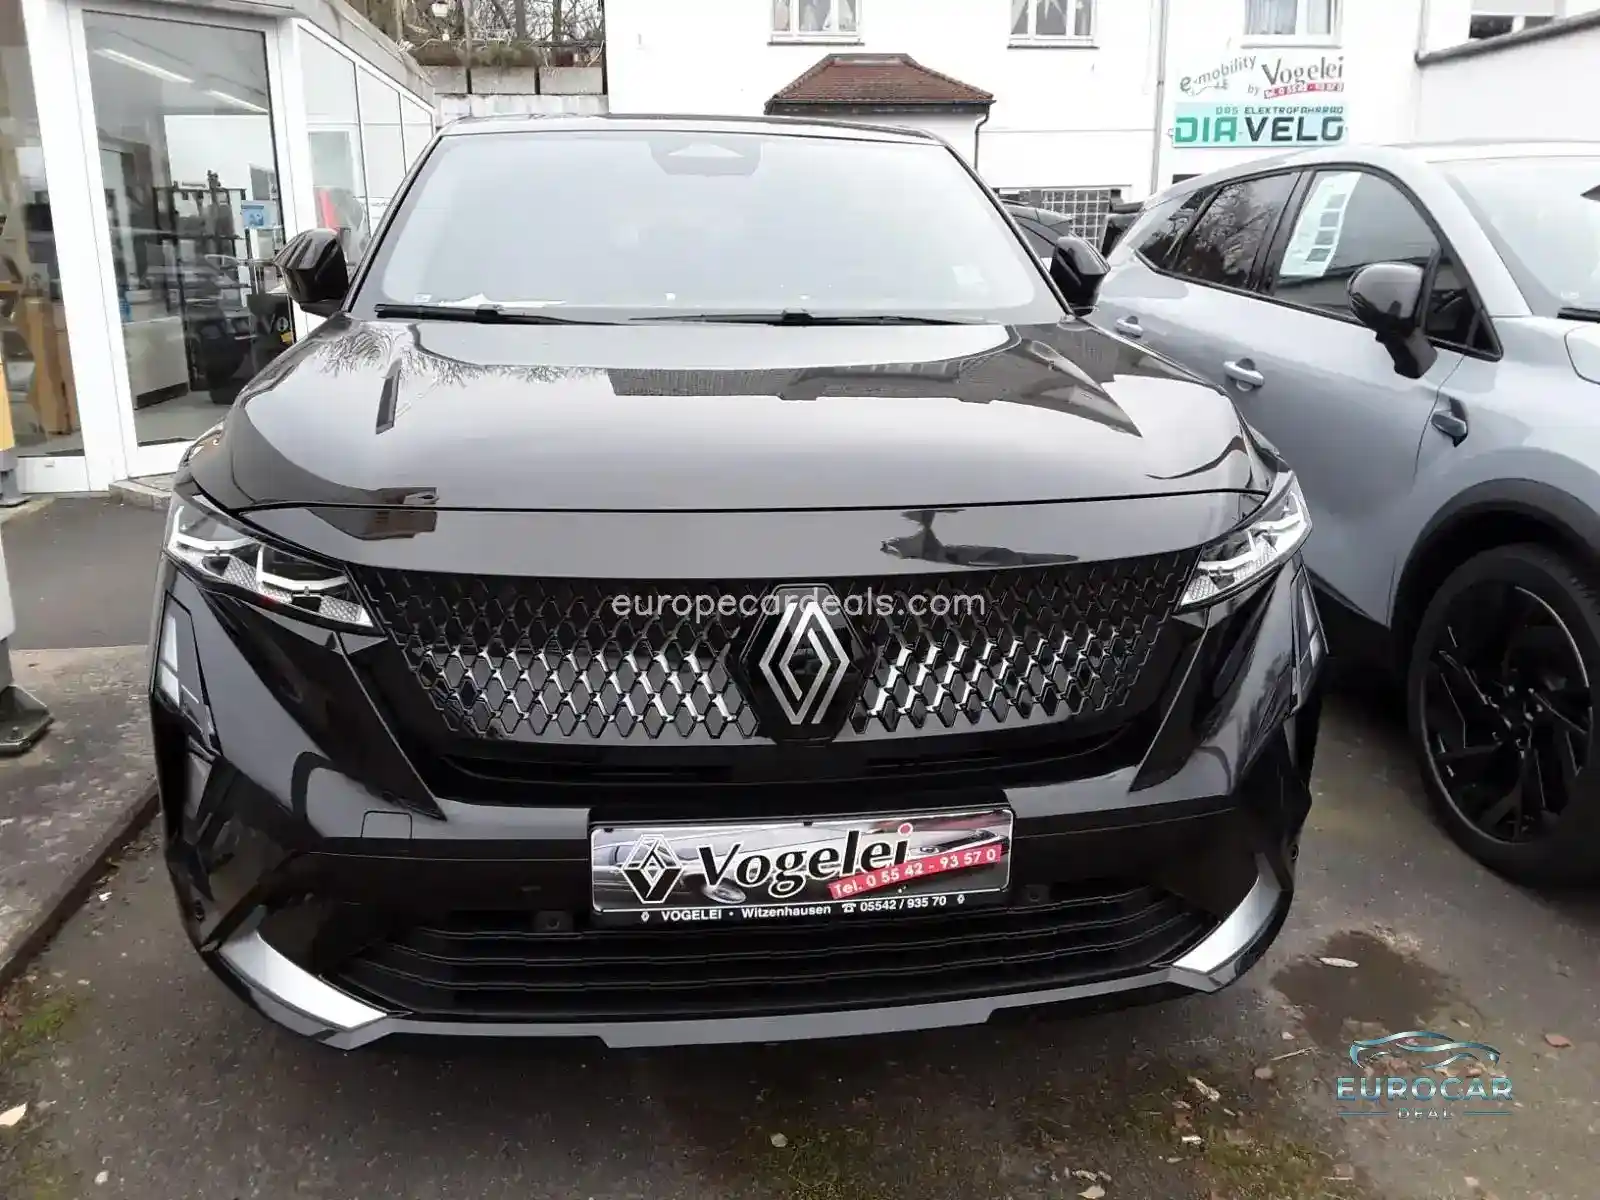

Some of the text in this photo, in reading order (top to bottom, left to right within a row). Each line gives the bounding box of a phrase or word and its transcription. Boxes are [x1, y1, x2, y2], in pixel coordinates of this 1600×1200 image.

[1247, 83, 1260, 96] by
[1261, 56, 1344, 85] Vogelei
[697, 822, 914, 898] Vogelei
[834, 882, 863, 897] Tel.
[866, 875, 876, 887] 0
[881, 870, 900, 884] 55
[904, 863, 923, 877] 42
[940, 855, 959, 870] 93
[963, 851, 982, 865] 57
[986, 848, 996, 861] 0
[661, 909, 722, 922] VOGELEI
[741, 904, 832, 920] Witzenhausen
[860, 902, 897, 912] 05542
[907, 898, 929, 909] 935
[932, 896, 947, 906] 70
